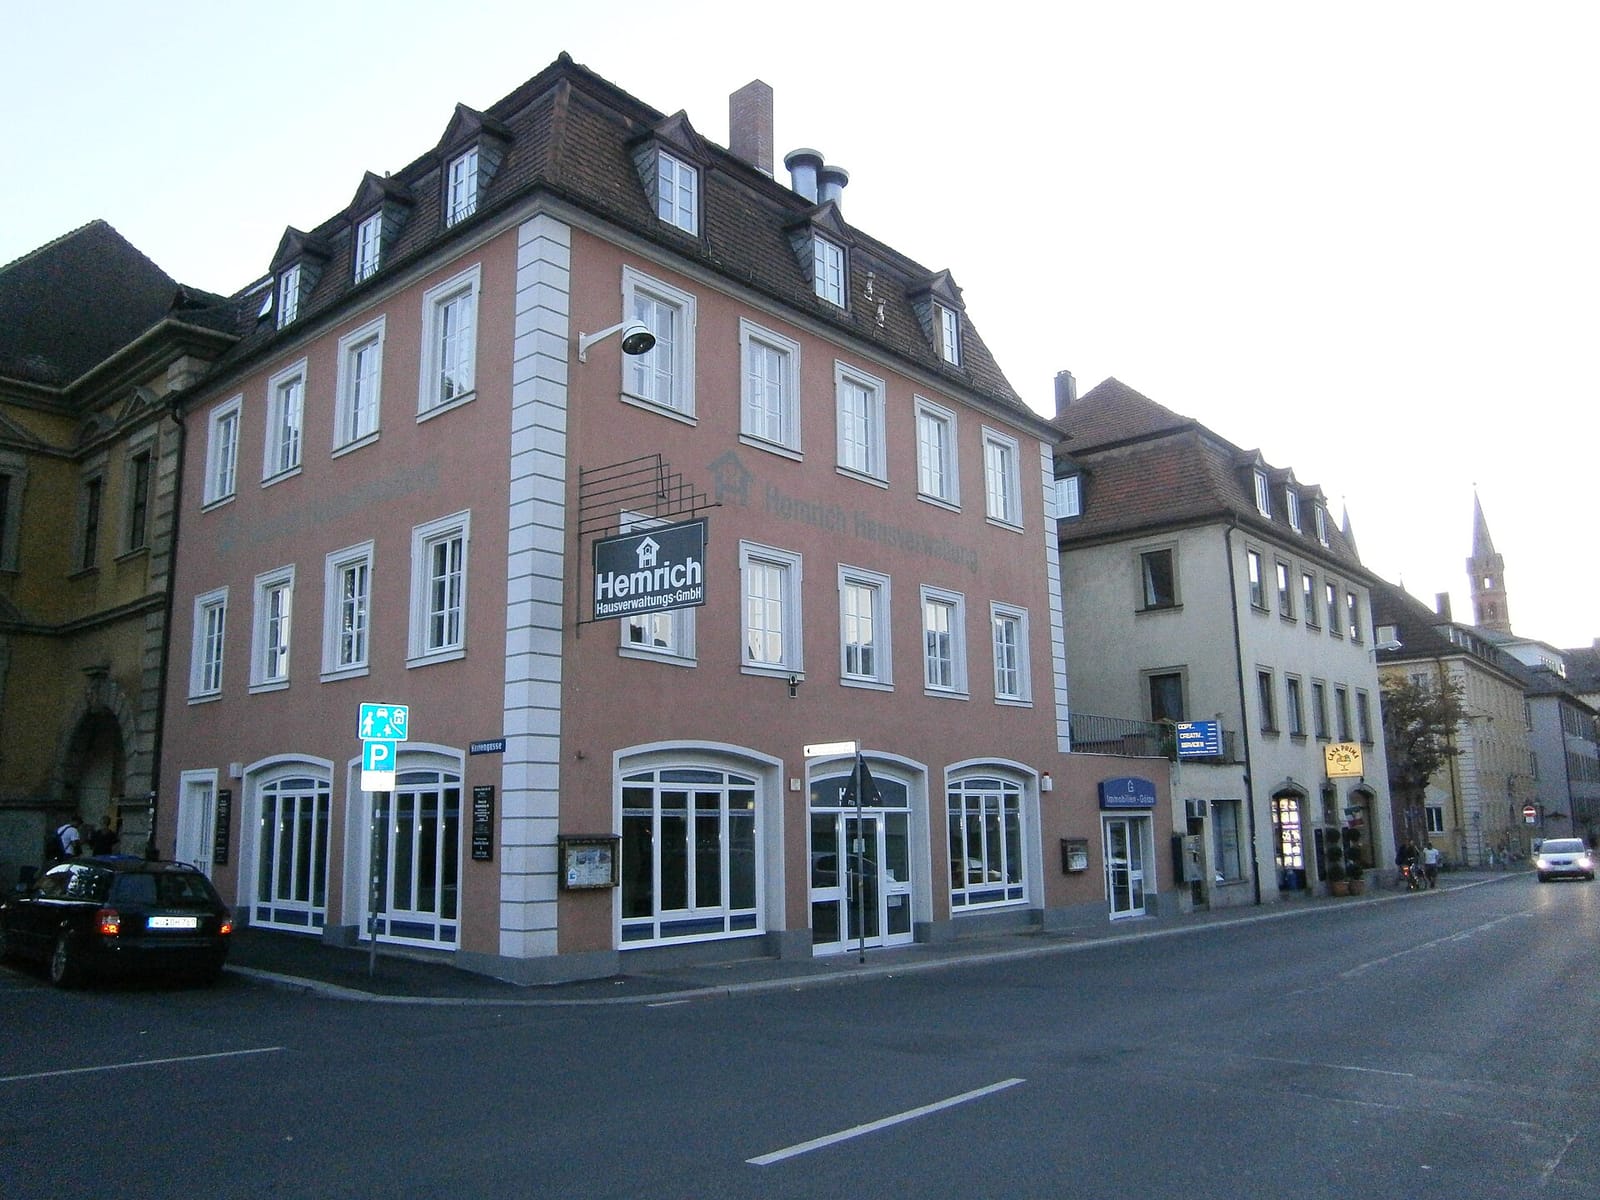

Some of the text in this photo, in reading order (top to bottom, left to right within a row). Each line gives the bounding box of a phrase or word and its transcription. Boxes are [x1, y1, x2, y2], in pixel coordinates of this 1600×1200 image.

[596, 556, 702, 600] Hemrich
[596, 586, 702, 615] Hausverwaltungs-GmbH
[370, 743, 389, 770] P
[1328, 745, 1359, 761] CASA PRIMA
